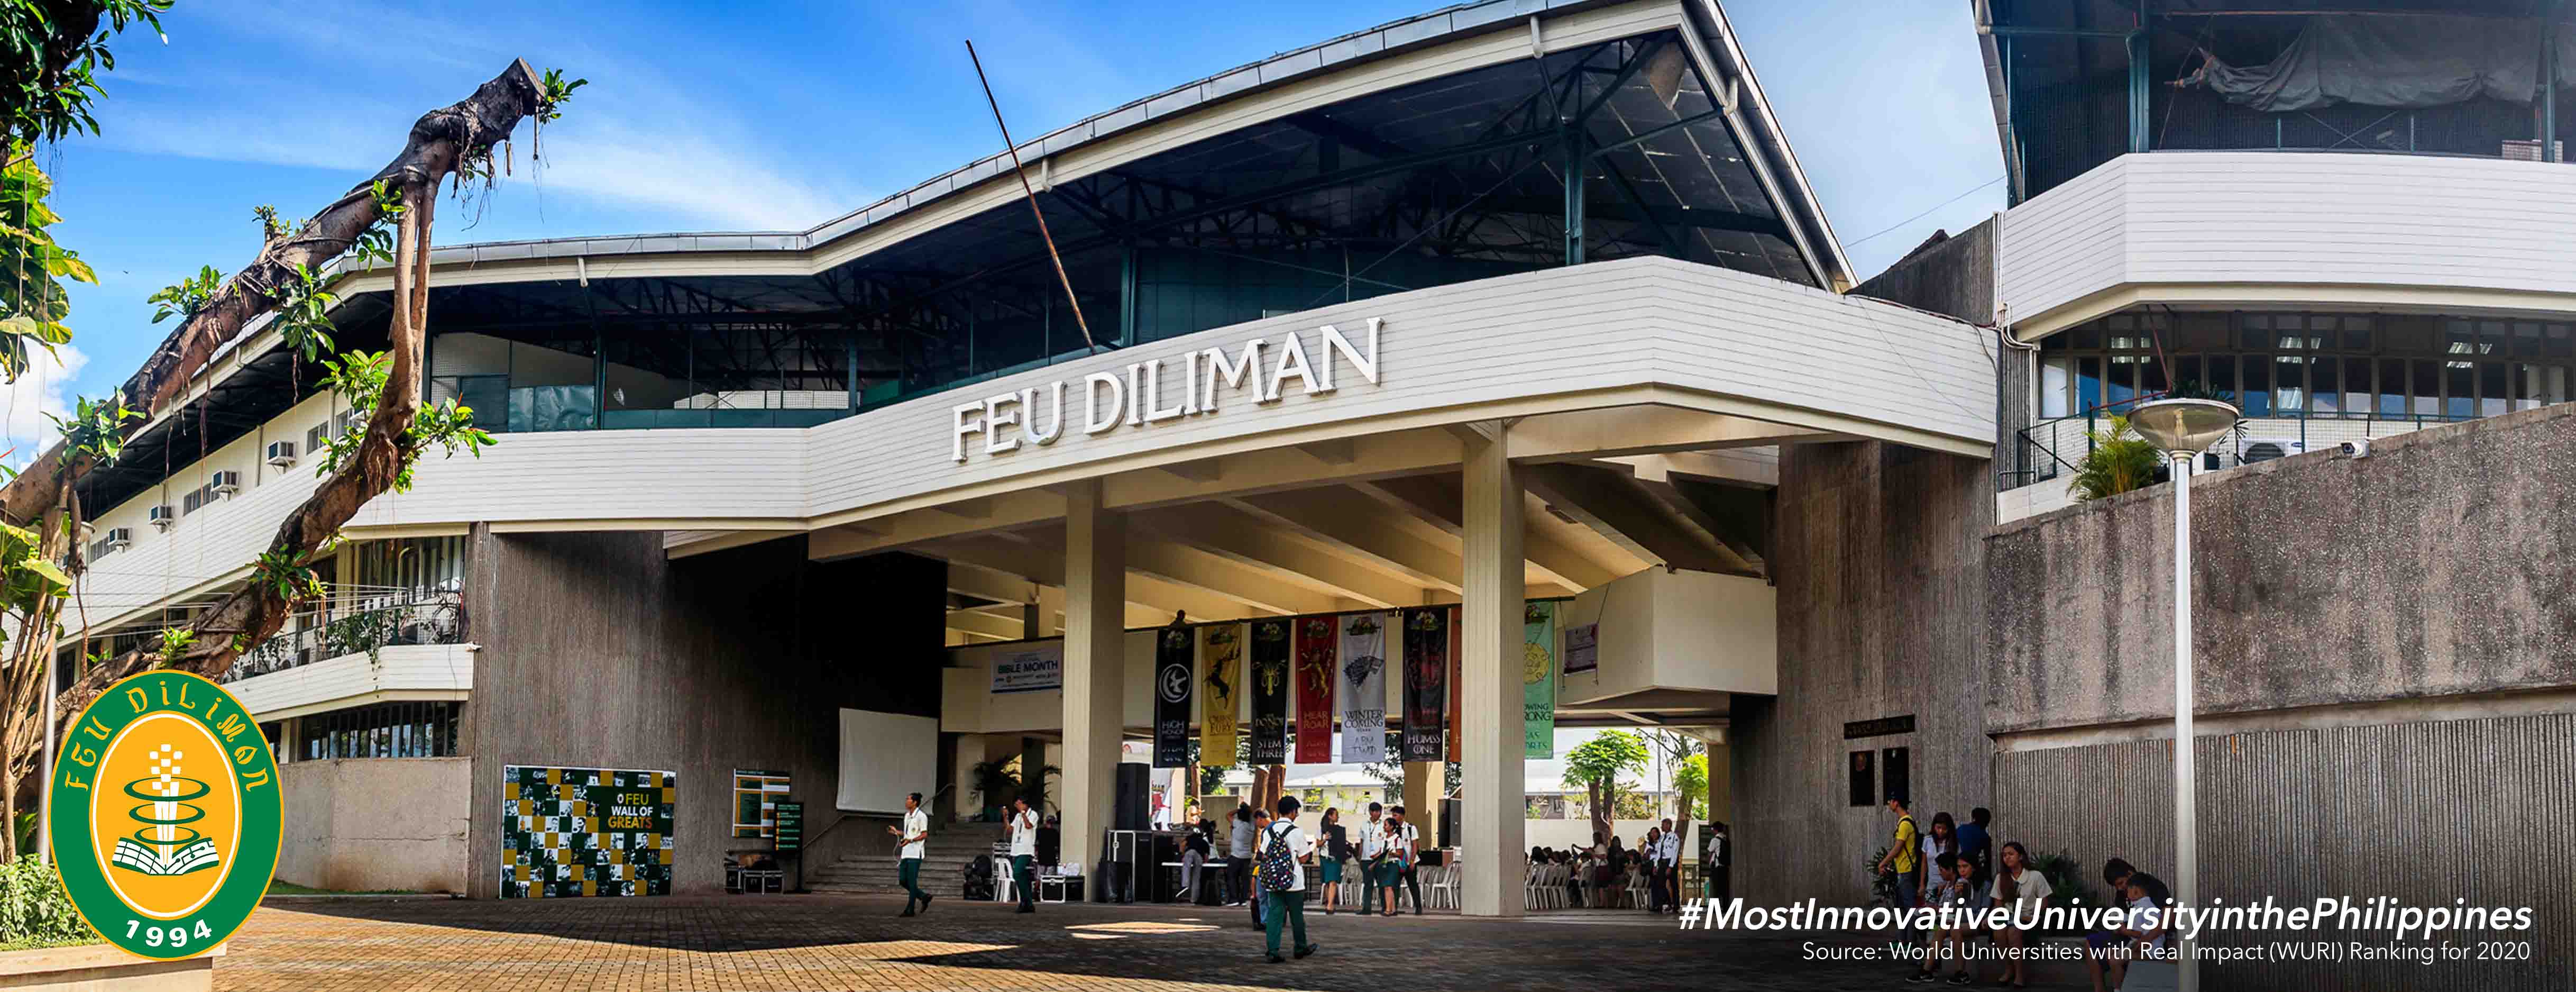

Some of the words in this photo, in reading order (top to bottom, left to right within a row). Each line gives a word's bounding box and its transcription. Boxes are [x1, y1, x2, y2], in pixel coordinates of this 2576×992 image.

[952, 380, 1067, 462] FEU
[1083, 317, 1384, 435] DILIMAN
[1023, 660, 1058, 672] MONTH
[1303, 711, 1328, 720] HEAR
[1345, 710, 1383, 720] WINTER
[1162, 720, 1185, 729] HIGH
[1303, 719, 1328, 729] ROAR
[1344, 719, 1383, 729] COMING
[1257, 740, 1282, 749] STEM
[1413, 744, 1435, 754] ONE
[1257, 748, 1284, 758] THREE
[611, 806, 638, 816] WALL
[639, 806, 653, 816] OF
[608, 816, 652, 829] GREATS
